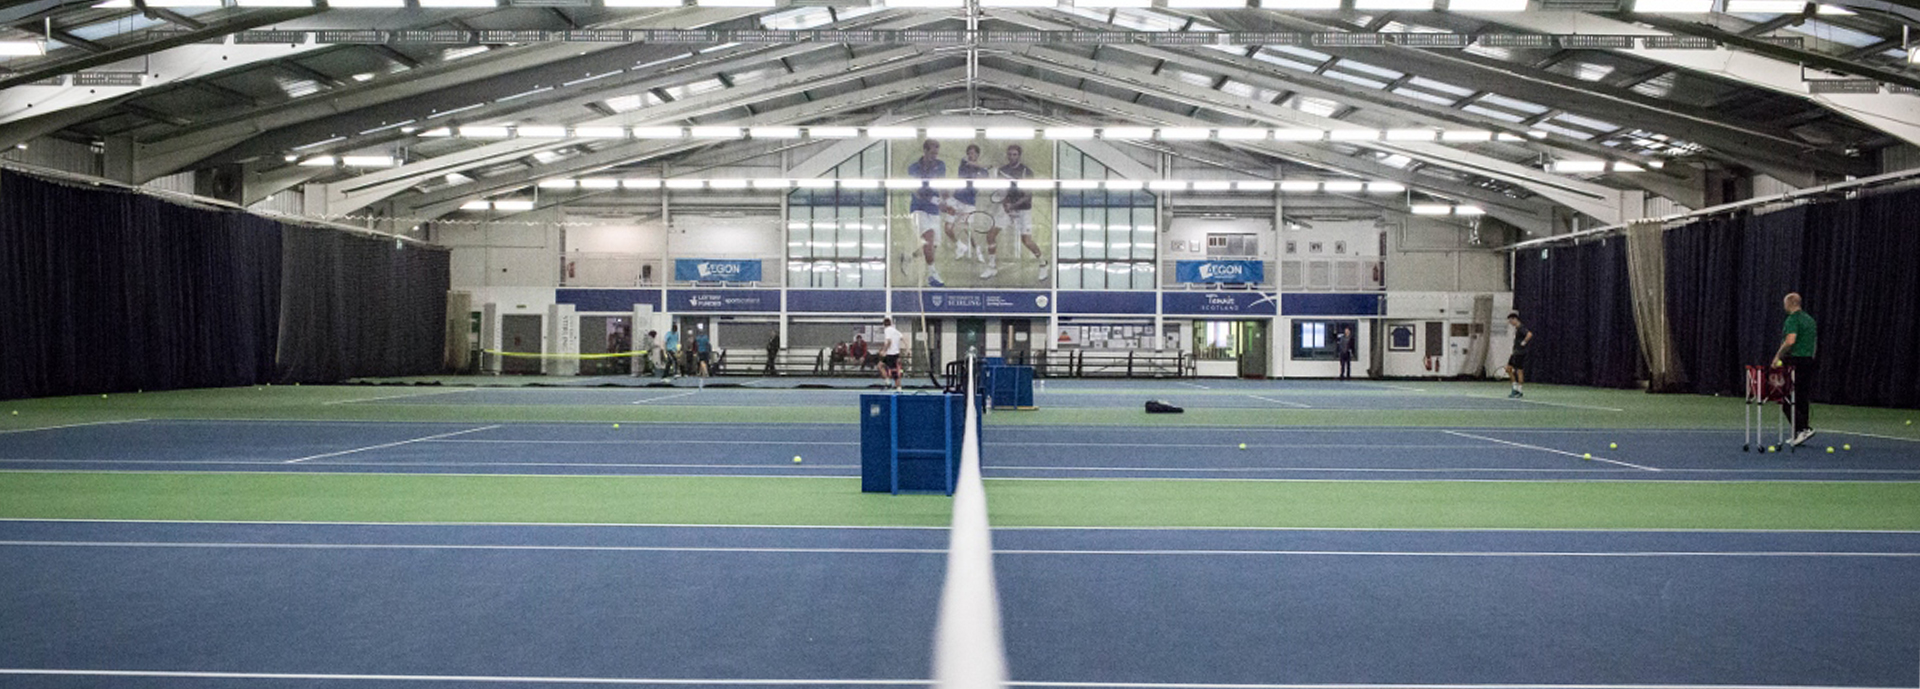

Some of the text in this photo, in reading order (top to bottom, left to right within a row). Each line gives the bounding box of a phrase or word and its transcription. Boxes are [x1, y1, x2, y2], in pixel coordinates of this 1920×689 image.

[701, 262, 740, 275] AEGON
[1202, 264, 1243, 276] AEGON
[1206, 294, 1235, 305] Tennis
